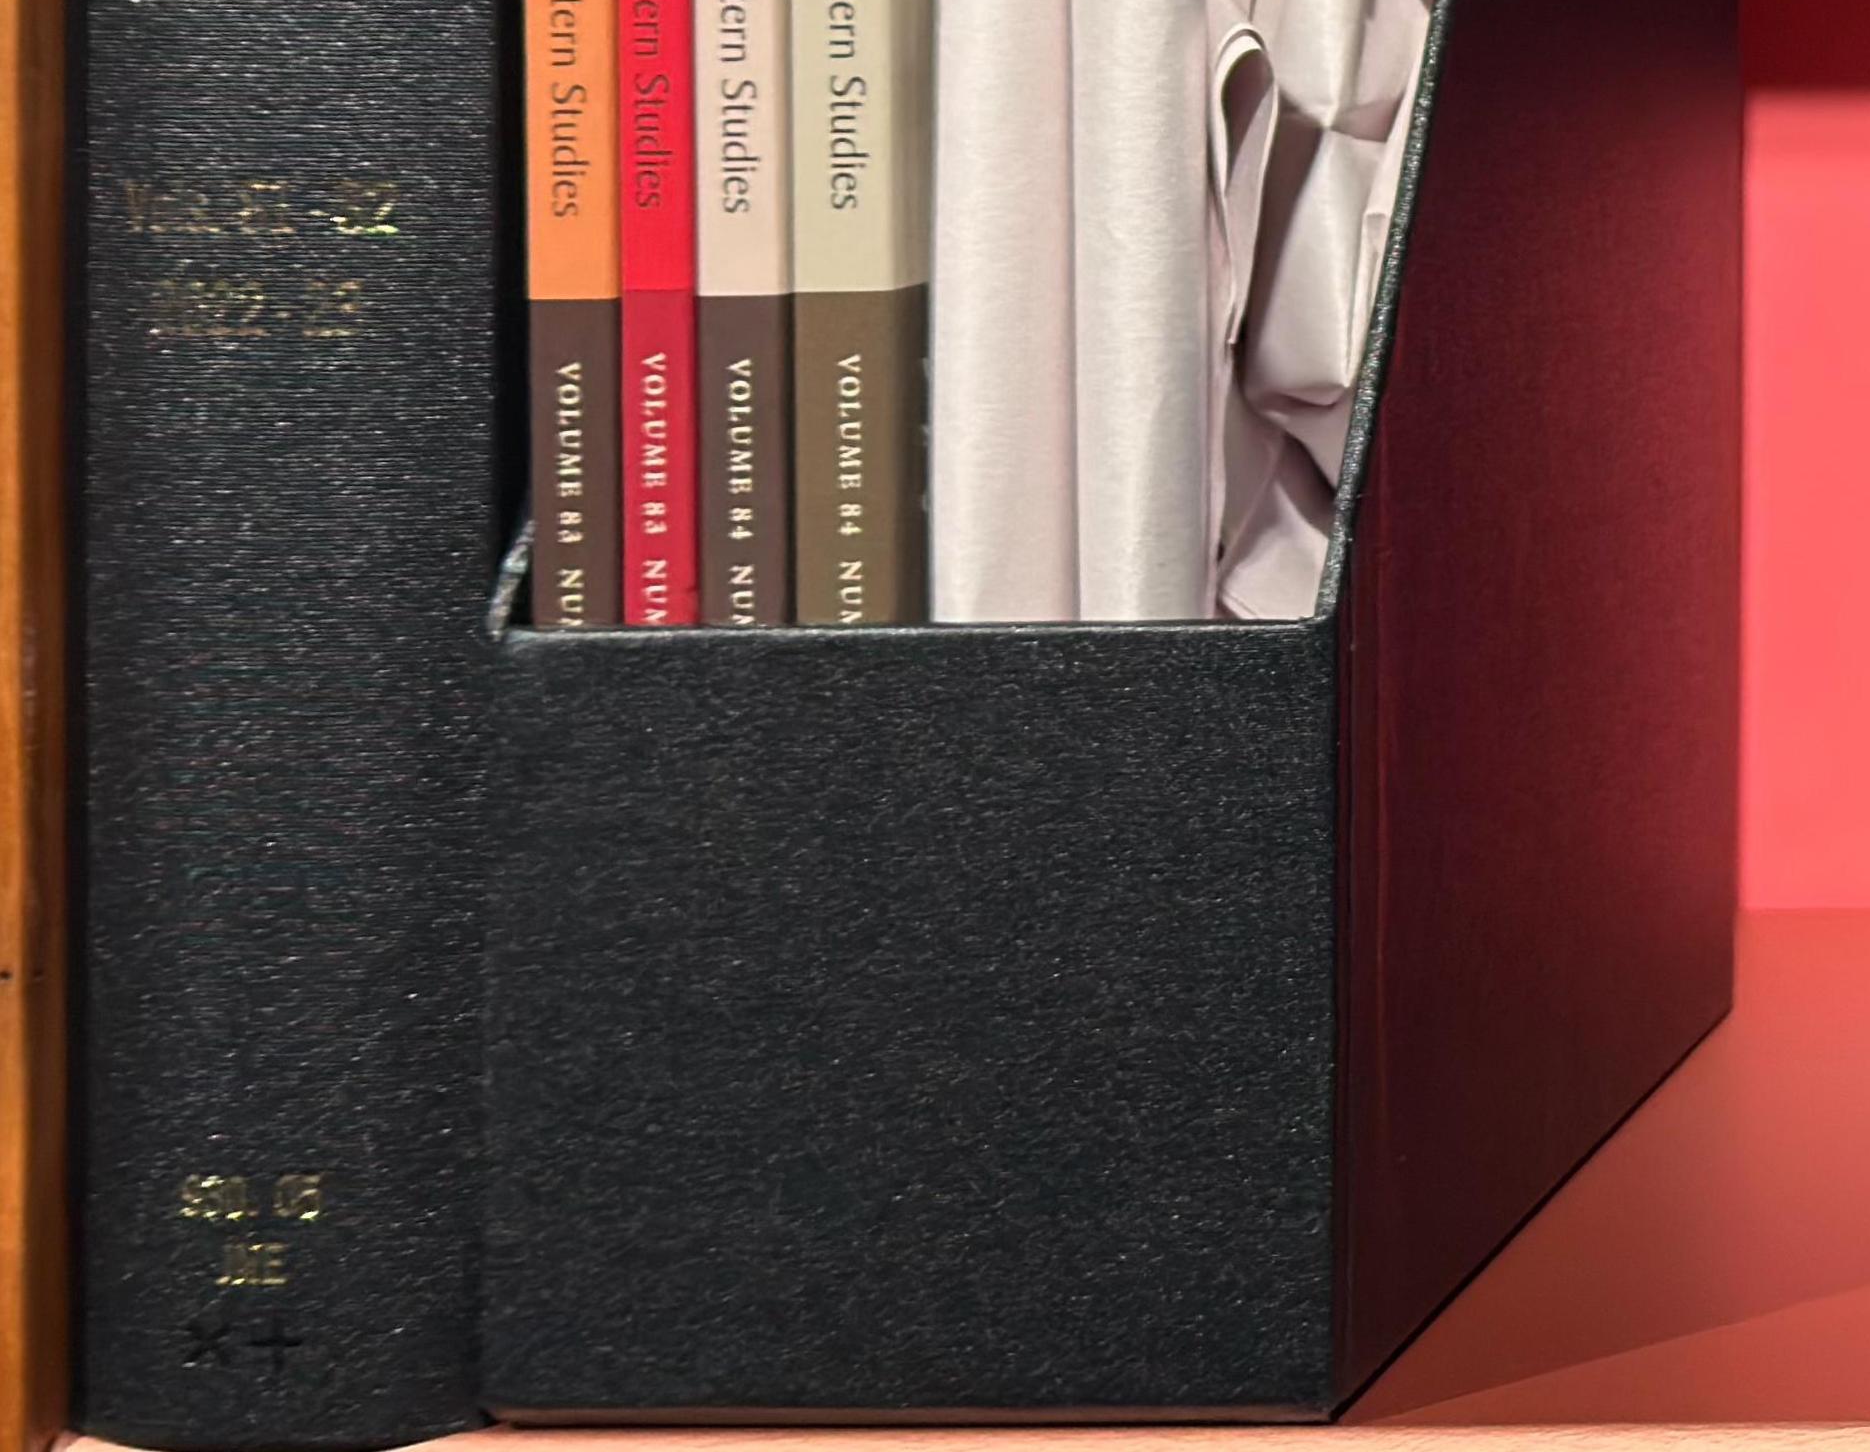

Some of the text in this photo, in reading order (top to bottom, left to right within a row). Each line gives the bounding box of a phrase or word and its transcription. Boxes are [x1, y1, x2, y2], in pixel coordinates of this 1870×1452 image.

[551, 84, 591, 218] Studies
[634, 74, 672, 210] Studies
[721, 79, 761, 215] Studies
[830, 75, 870, 211] Studies
[641, 353, 668, 489] VOLUME
[728, 359, 753, 495] VOLUME
[838, 354, 863, 490] VOLUME
[557, 362, 585, 625] VOLUME 83 NU
[642, 502, 668, 535] 83
[729, 508, 754, 540] 84
[839, 504, 863, 536] 84
